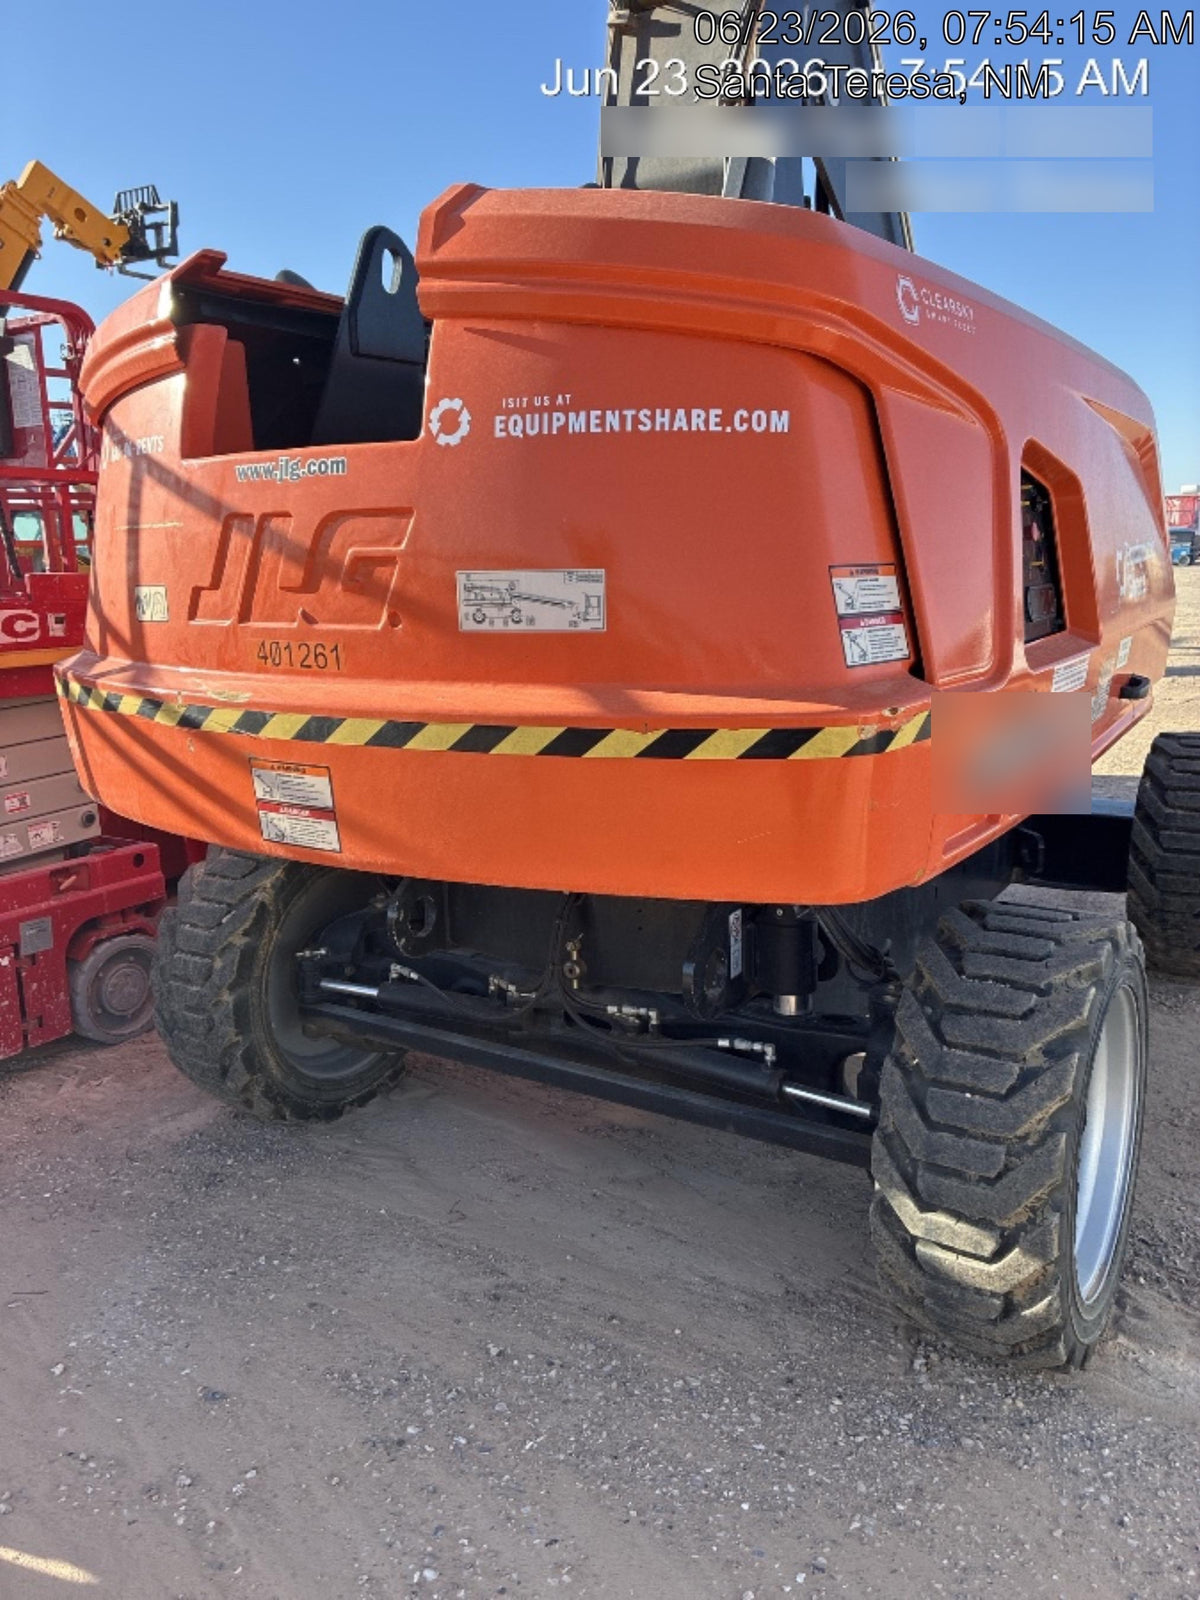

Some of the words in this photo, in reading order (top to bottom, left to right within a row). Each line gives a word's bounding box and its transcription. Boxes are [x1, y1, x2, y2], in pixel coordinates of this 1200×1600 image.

[534, 395, 550, 407] US
[556, 393, 572, 407] AT
[493, 407, 790, 439] EQUIPMENTSHARE.COM
[235, 457, 347, 484] www.jlg.com
[187, 507, 416, 630] JLG
[257, 640, 342, 670] 401261
